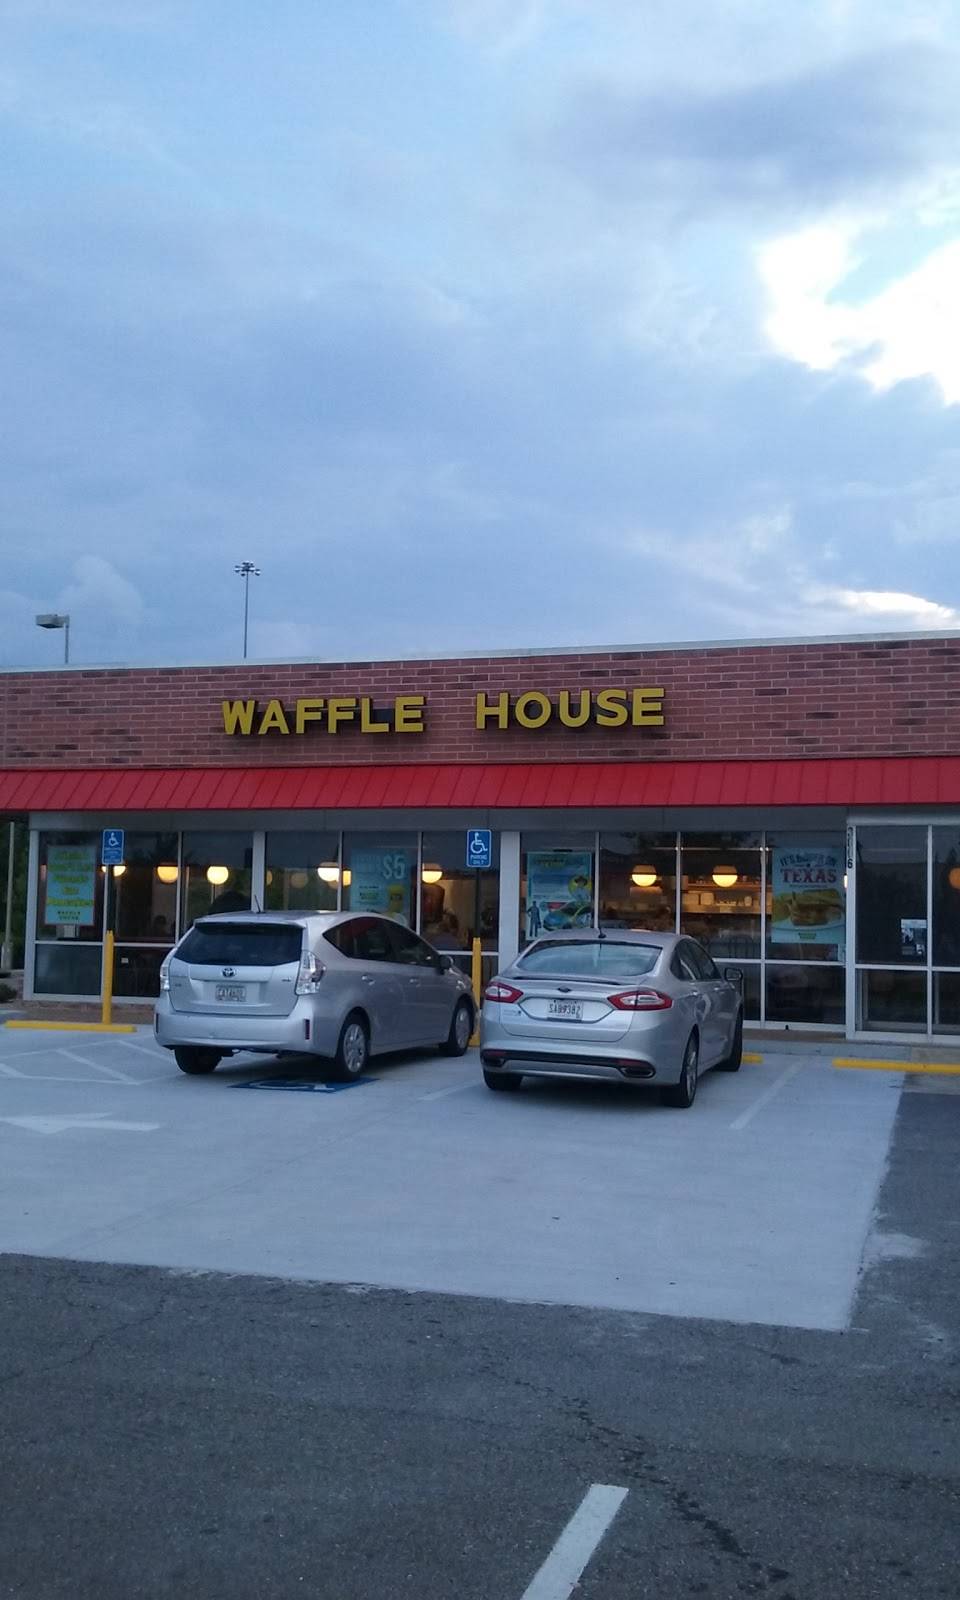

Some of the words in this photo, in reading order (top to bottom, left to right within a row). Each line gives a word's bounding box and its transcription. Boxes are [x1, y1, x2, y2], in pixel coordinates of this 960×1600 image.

[222, 696, 425, 735] WAFFLE
[475, 687, 666, 729] HOUSE
[383, 854, 406, 880] $5
[780, 868, 837, 883] TEXAS
